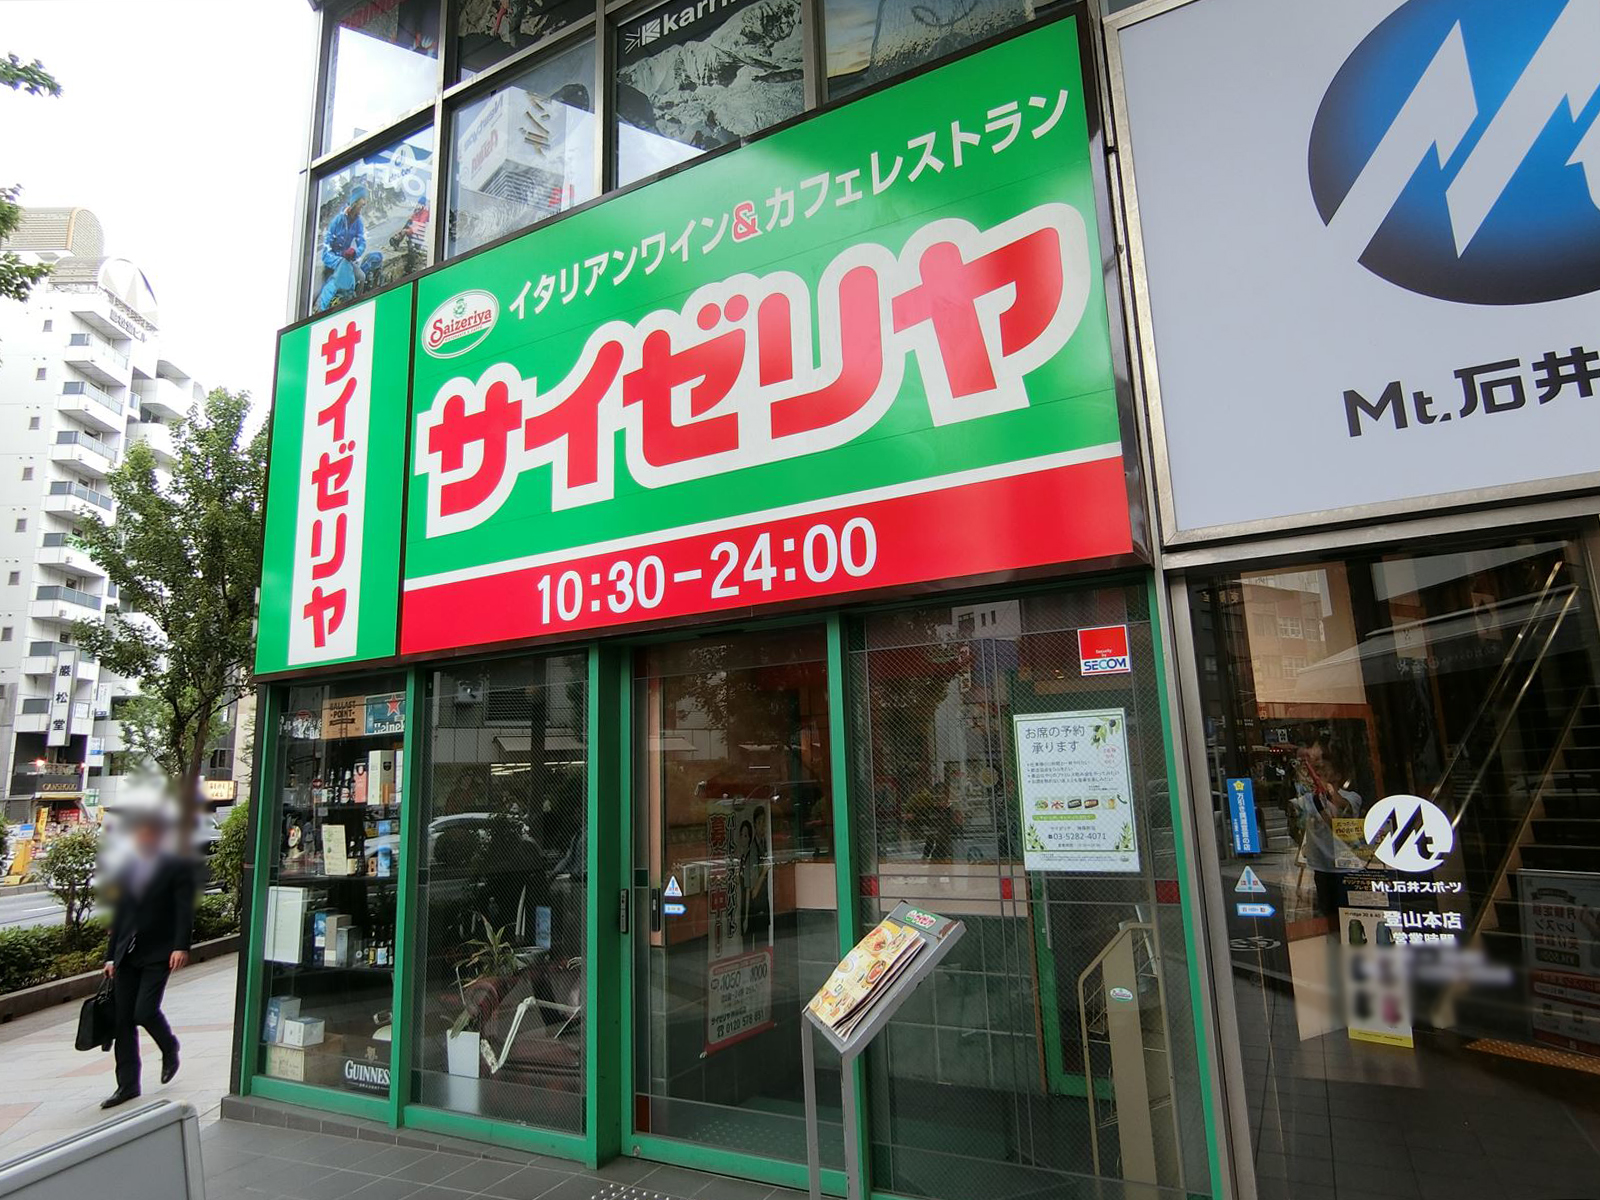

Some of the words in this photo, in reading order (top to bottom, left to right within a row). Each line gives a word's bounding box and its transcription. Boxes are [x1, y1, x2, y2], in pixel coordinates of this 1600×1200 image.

[509, 89, 1068, 319] イタリアンワイン&カフェレストラン
[429, 309, 492, 348] Saizeriya
[422, 214, 1076, 528] サイゼリヤ
[304, 320, 361, 648] サイゼリヤ
[1084, 657, 1127, 671] SECOM
[333, 710, 353, 719] POINT
[1025, 724, 1085, 739] お席の予約
[1032, 740, 1079, 754] 承ります
[1053, 832, 1107, 841] 03-5282-4071
[1383, 910, 1463, 930] 登山本店
